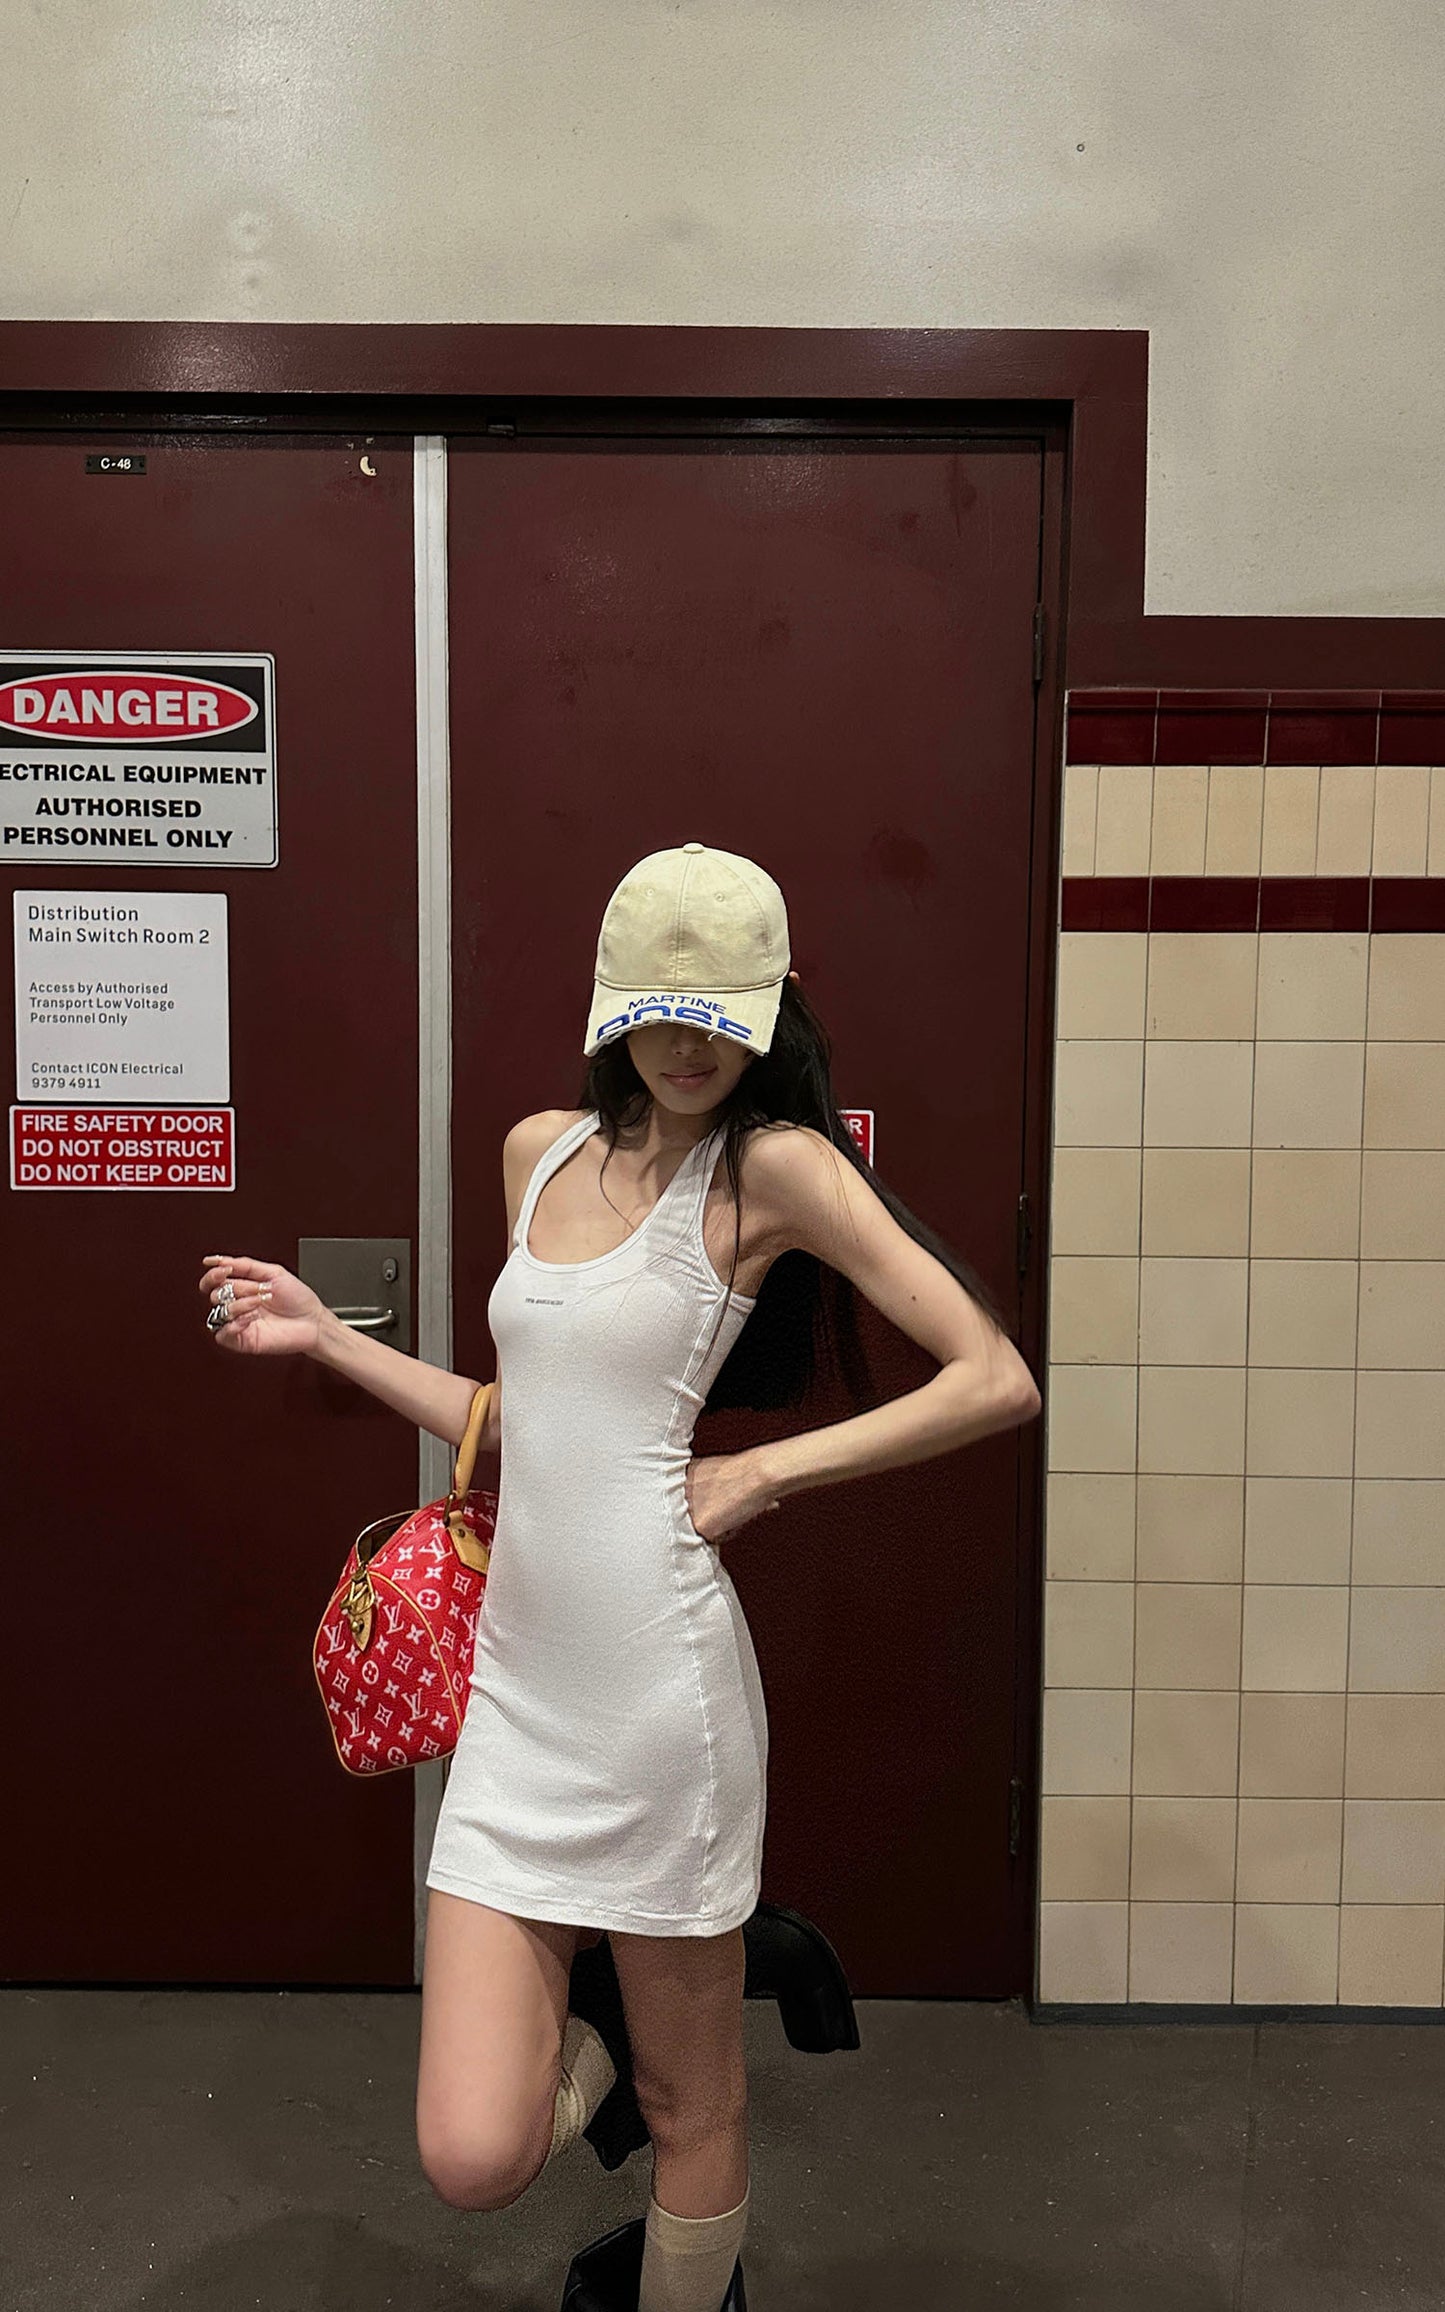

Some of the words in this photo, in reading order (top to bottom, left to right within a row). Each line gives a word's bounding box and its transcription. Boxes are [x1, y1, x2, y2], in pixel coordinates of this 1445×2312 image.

[100, 457, 131, 470] C-48
[13, 688, 220, 726] DANGER
[0, 764, 115, 782] ECTRICAL
[123, 766, 267, 785] EQUIPMENT
[35, 798, 202, 818] AUTHORISED
[4, 827, 158, 847] PERSONNEL
[166, 830, 233, 848] ONLY
[28, 905, 139, 921] Distribution
[28, 928, 72, 943] Main
[76, 928, 138, 943] Switch
[143, 930, 194, 944] Room
[199, 930, 210, 944] 2
[30, 982, 75, 993] Access
[78, 983, 93, 995] by
[96, 982, 168, 994] Authorised
[30, 997, 93, 1011] Transport
[97, 998, 121, 1009] Low
[125, 998, 175, 1012] Voltage
[628, 995, 726, 1015] MARTINE
[30, 1012, 95, 1024] Personnel
[99, 1013, 128, 1026] Only
[31, 1062, 83, 1074] Contact
[86, 1063, 118, 1074] ICON
[122, 1063, 183, 1075] Electrical
[32, 1078, 66, 1089] 9379
[69, 1078, 101, 1089] 4911
[22, 1115, 68, 1132] FIRE
[74, 1115, 156, 1132] SAFETY
[161, 1116, 224, 1133] DOOR
[22, 1139, 53, 1157] DO
[59, 1140, 103, 1157] NOT
[108, 1140, 224, 1158] OBSTRUCT
[20, 1164, 51, 1182] DO
[57, 1164, 101, 1182] NOT
[106, 1165, 163, 1182] KEEP
[167, 1165, 226, 1182] OPEN
